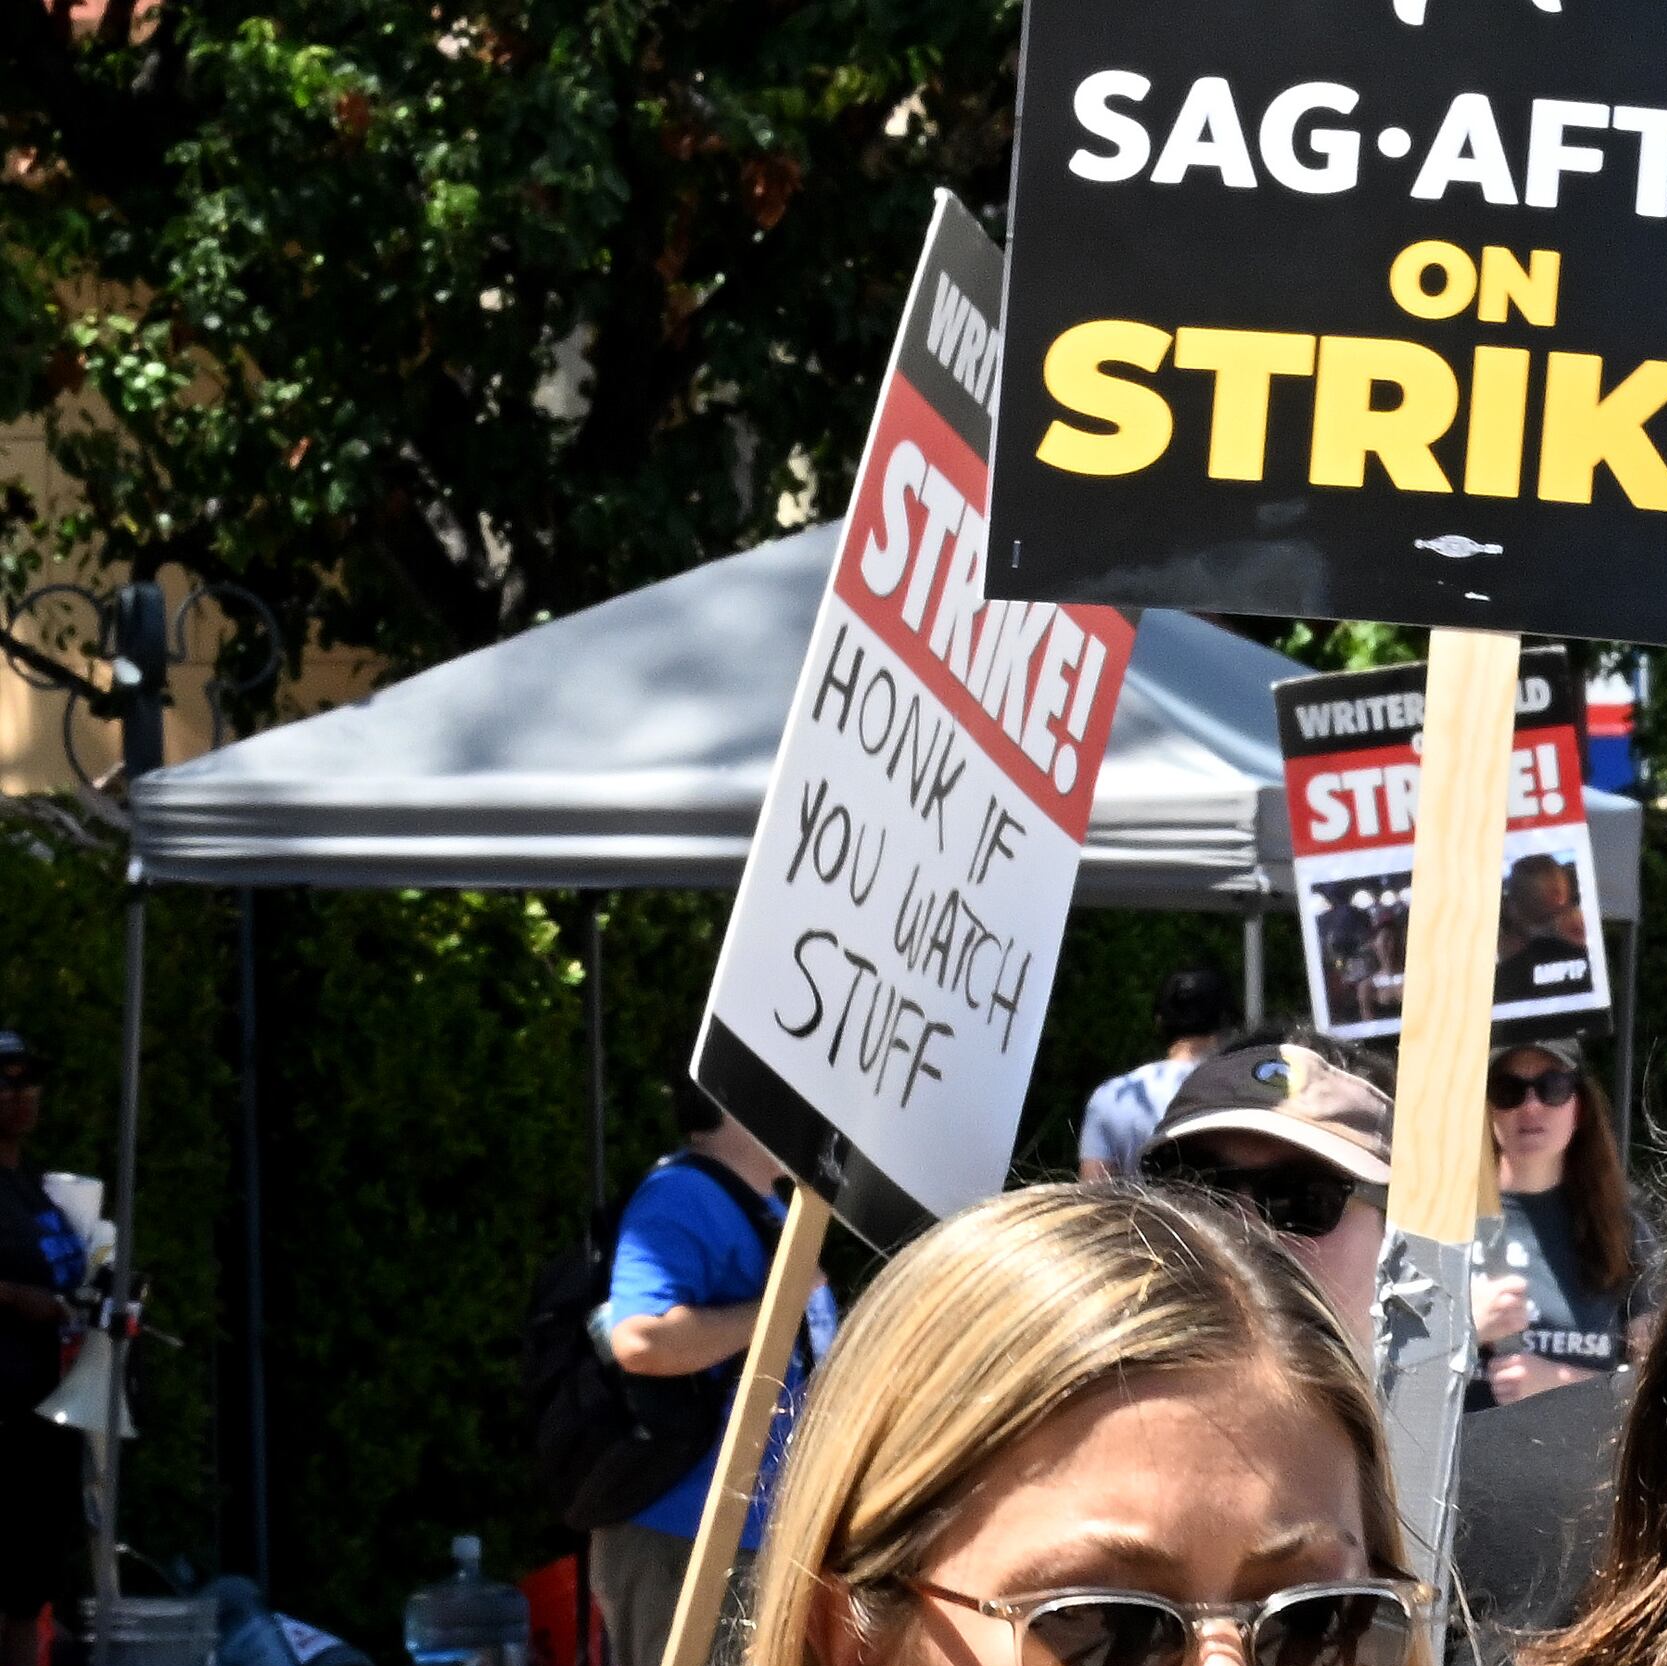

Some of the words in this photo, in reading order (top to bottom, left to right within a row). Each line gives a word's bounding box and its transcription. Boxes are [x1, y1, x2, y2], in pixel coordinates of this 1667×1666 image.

[1389, 239, 1561, 327] ON
[860, 439, 1107, 795] STRIKE!
[812, 624, 967, 853] HONK
[967, 794, 1027, 886] IF
[1295, 691, 1426, 740] WRITER
[1305, 743, 1566, 843] STRE!
[785, 778, 887, 907] YOU
[893, 863, 1032, 1055] WATCH
[773, 926, 956, 1109] STUFF
